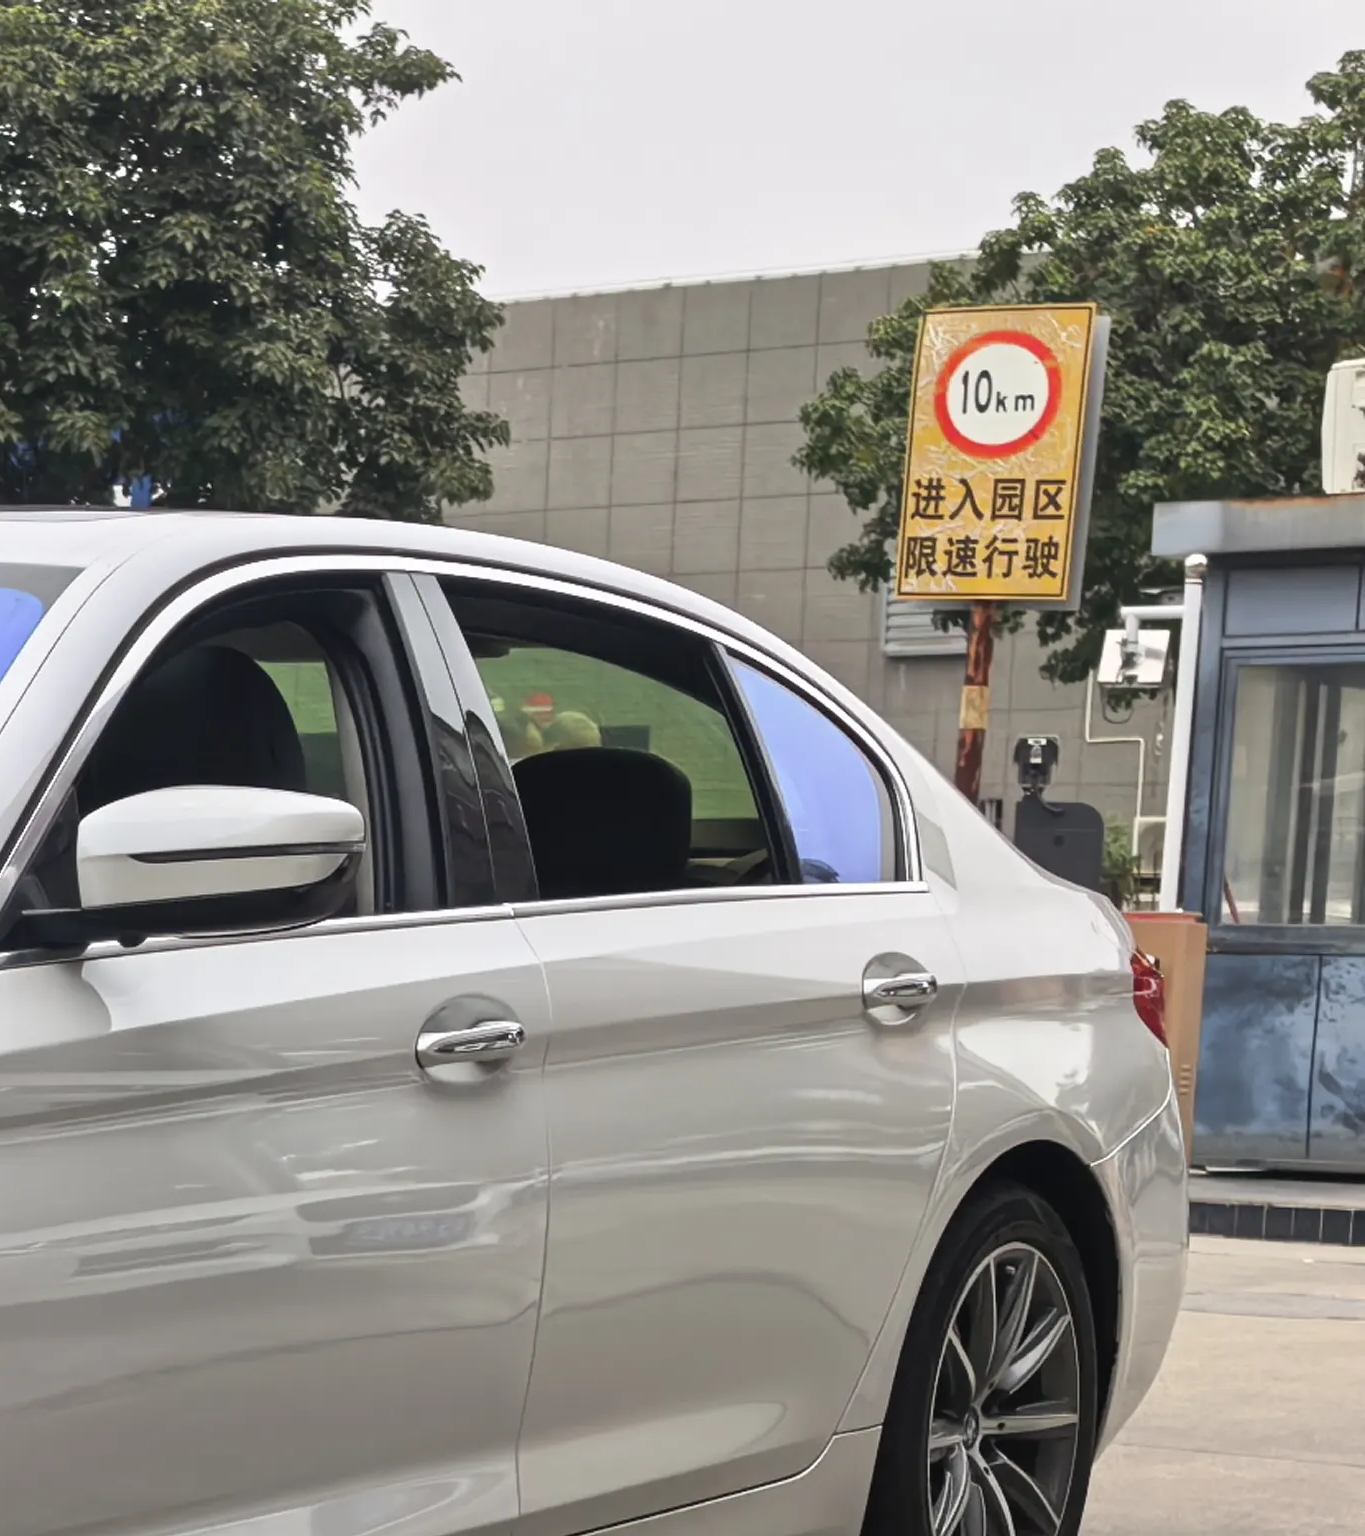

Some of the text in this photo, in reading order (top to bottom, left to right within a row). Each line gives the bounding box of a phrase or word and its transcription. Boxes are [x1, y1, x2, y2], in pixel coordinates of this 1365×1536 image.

[910, 476, 1068, 522] 进入园区
[903, 534, 1060, 580] 限速行驶
